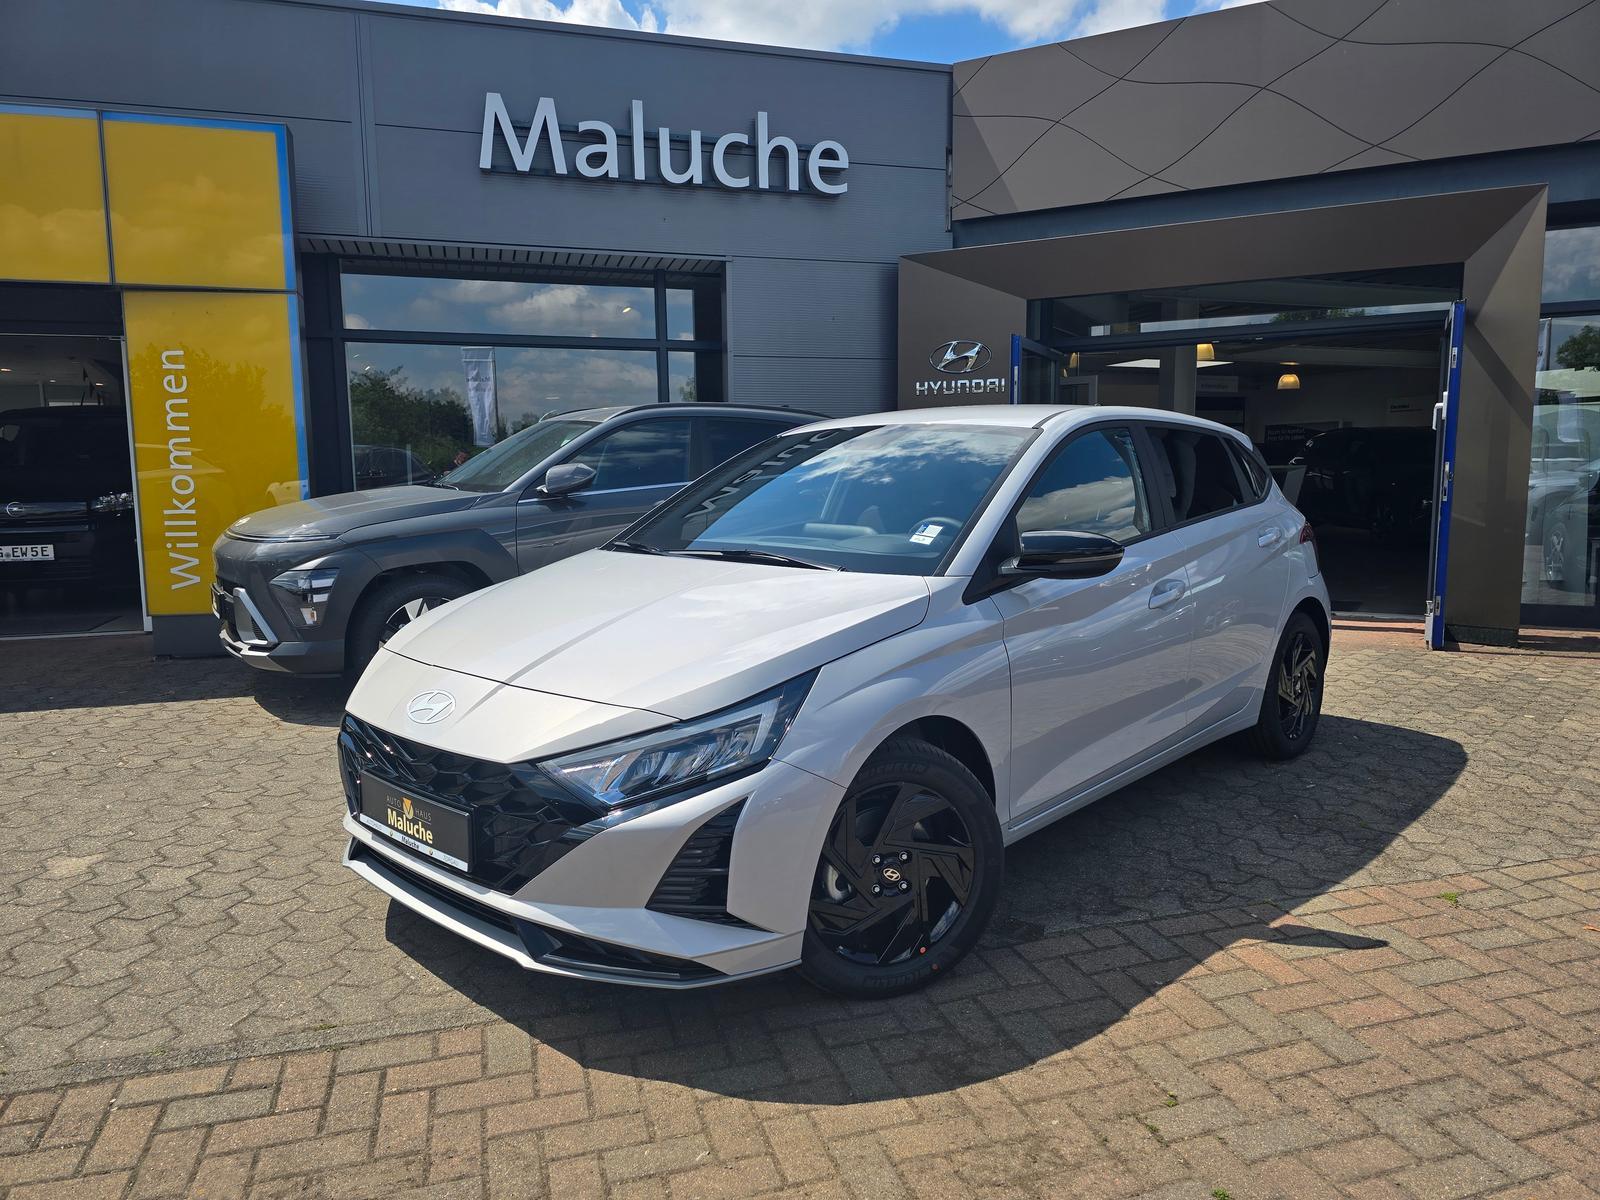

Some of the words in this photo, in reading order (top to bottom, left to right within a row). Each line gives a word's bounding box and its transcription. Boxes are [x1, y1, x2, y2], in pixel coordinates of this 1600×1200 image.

[480, 92, 849, 195] Maluche
[915, 378, 1006, 396] HYUNDAI
[161, 349, 200, 590] Willkommen
[386, 795, 401, 808] AUTO
[415, 808, 432, 821] HAUS
[387, 808, 433, 844] Maluche
